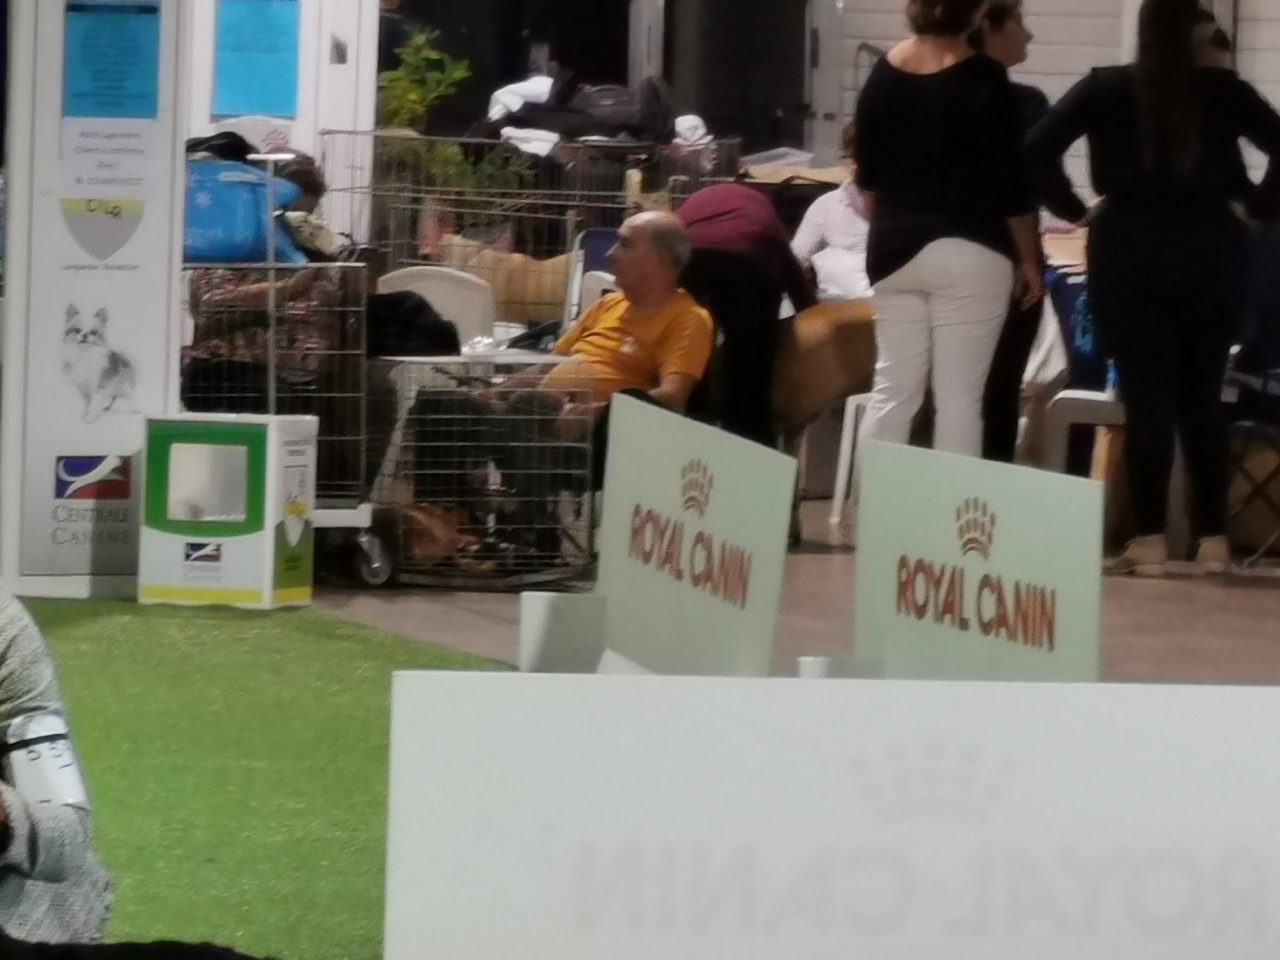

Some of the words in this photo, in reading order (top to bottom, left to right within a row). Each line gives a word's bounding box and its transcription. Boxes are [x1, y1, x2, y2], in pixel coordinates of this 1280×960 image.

[628, 503, 685, 582] ROYAL
[690, 530, 753, 610] CANIN
[896, 554, 970, 632] ROYAL
[977, 573, 1057, 652] CANIN
